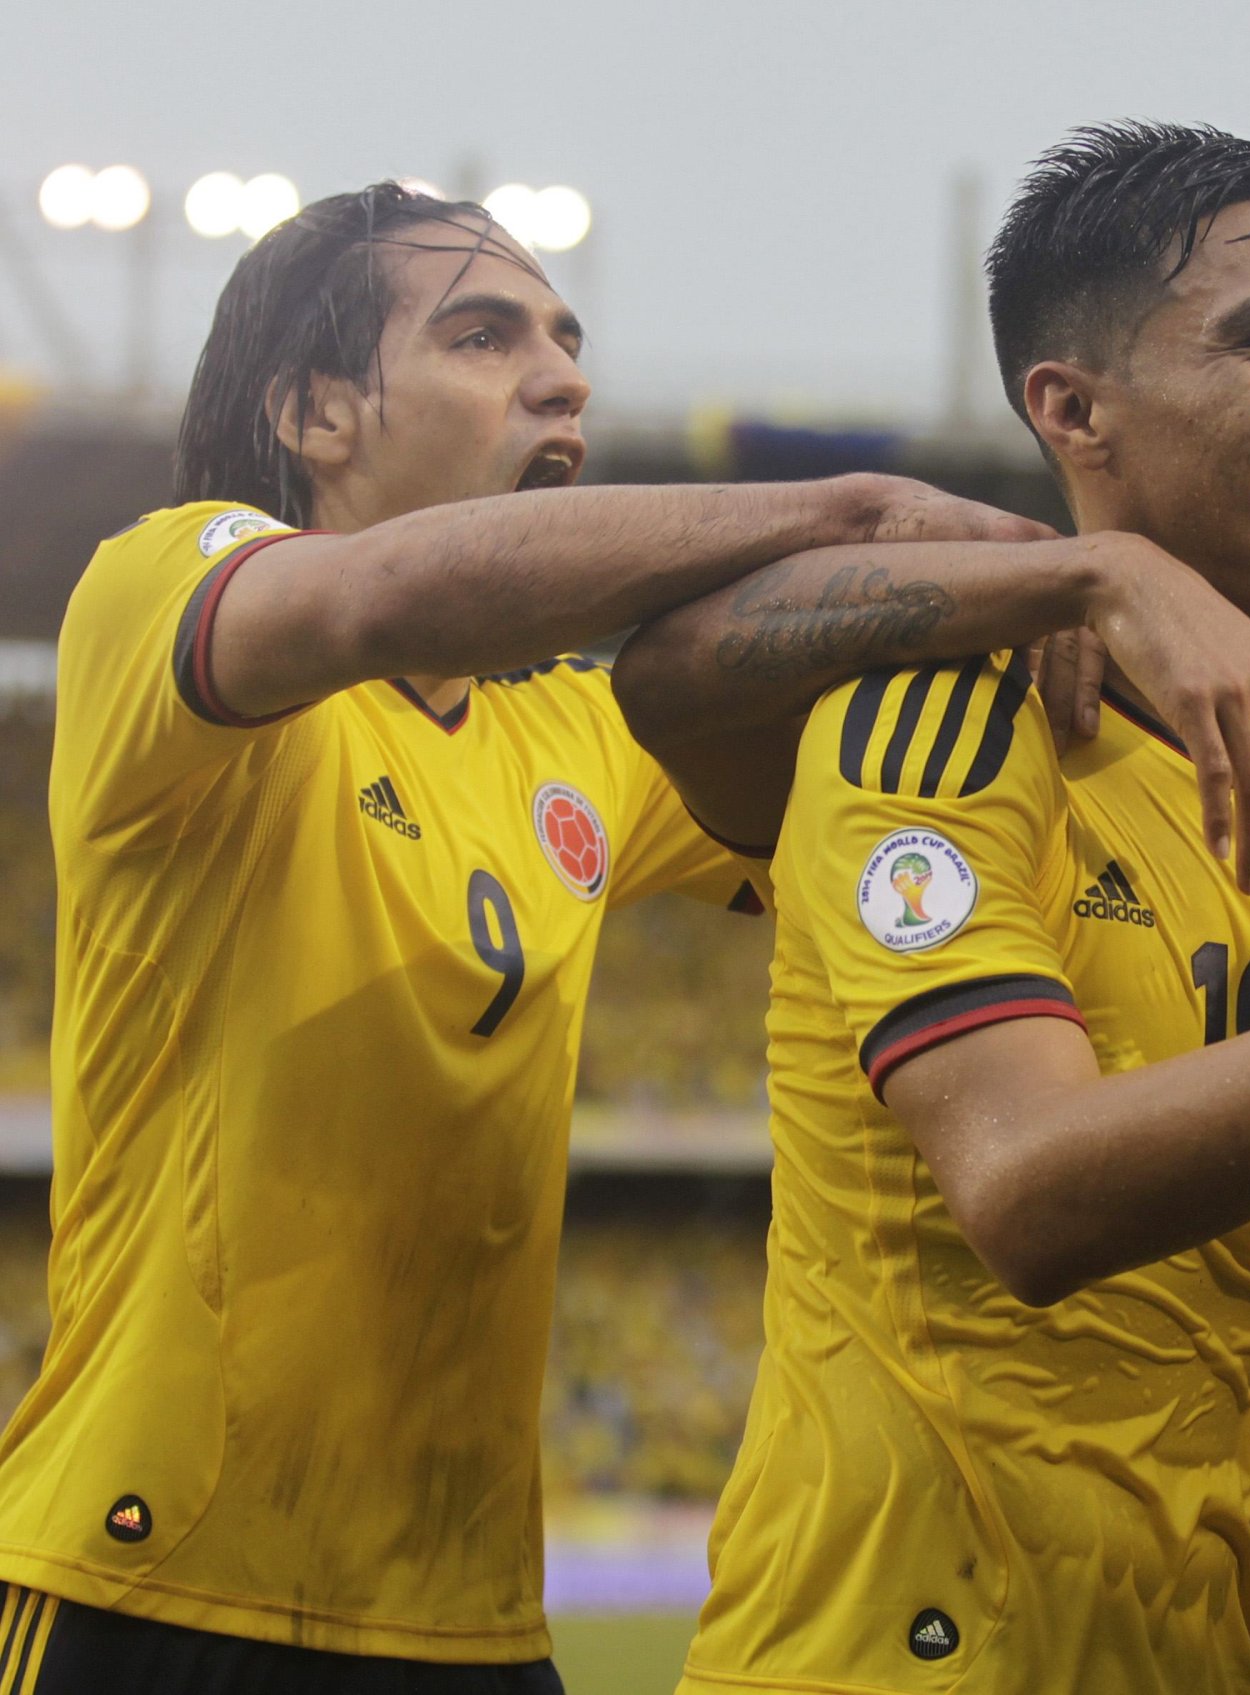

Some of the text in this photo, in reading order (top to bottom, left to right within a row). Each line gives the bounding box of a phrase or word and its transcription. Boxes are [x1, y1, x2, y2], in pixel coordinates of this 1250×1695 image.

[867, 856, 883, 876] FIFA
[883, 836, 919, 855] WORLD
[922, 837, 945, 850] CUP
[1073, 897, 1155, 928] adidas
[884, 919, 951, 945] QUALIFIERS
[467, 869, 525, 1037] 9
[915, 1631, 950, 1645] adidas
